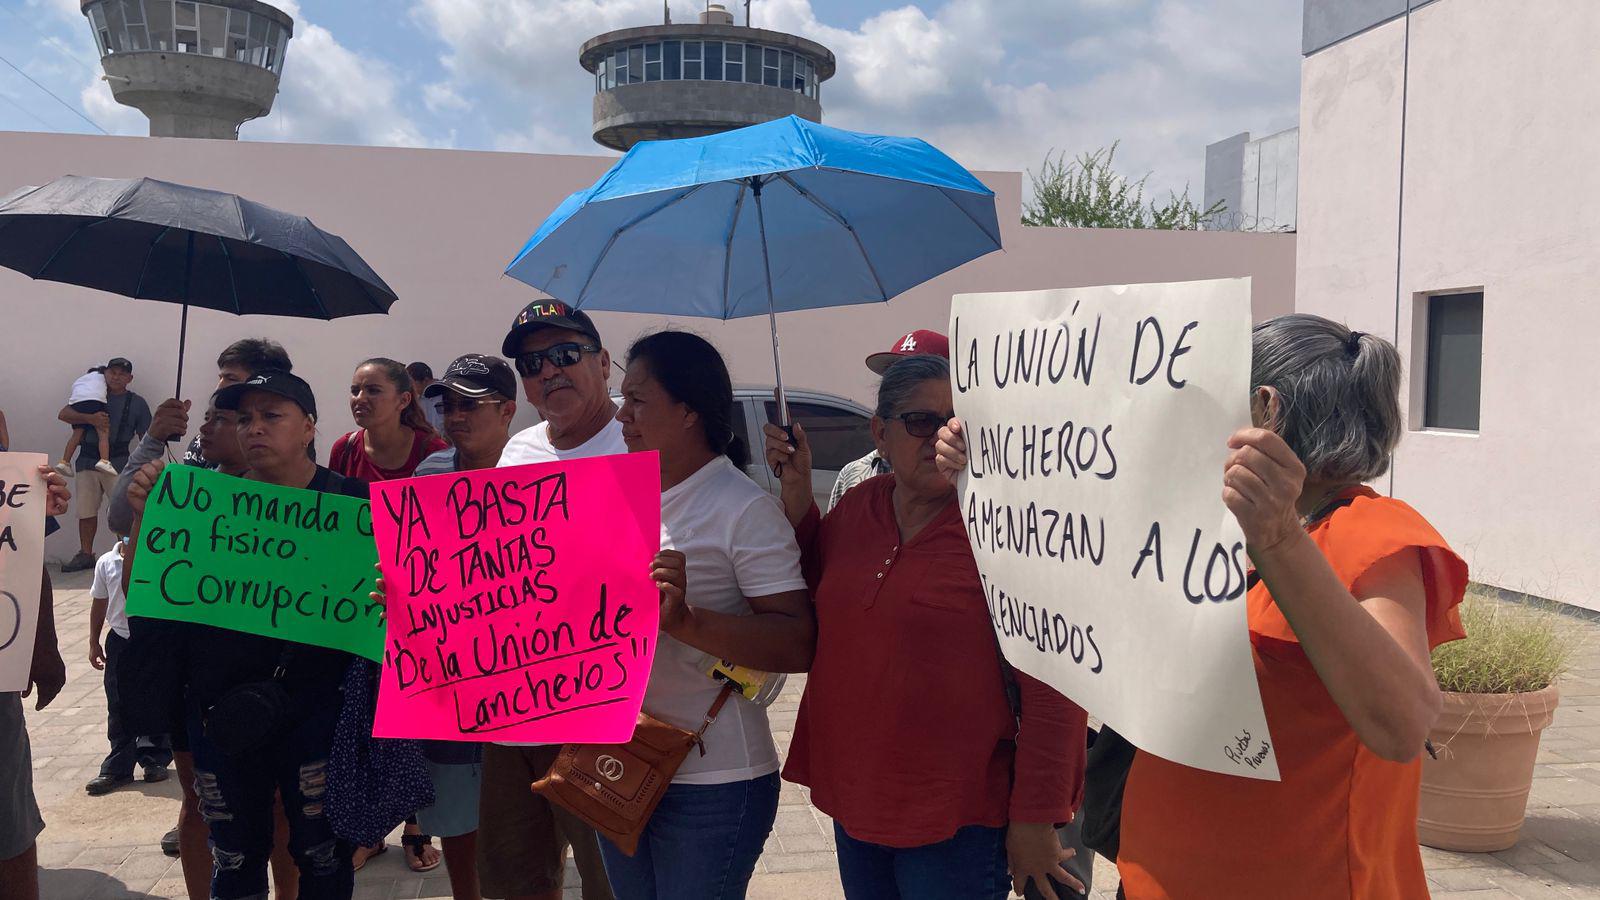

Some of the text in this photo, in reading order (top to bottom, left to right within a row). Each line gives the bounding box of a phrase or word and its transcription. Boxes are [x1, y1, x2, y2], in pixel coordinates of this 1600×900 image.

[955, 300, 1199, 393] LA UNIÓN DE
[965, 421, 1117, 480] LANCHEROS
[146, 526, 190, 553] en
[157, 471, 212, 510] No
[232, 491, 339, 533] manda
[381, 485, 431, 566] YA
[446, 471, 569, 539] BASTA
[403, 527, 555, 597] DE TANTAS
[968, 491, 1246, 604] AMENAZAN A LOS
[407, 569, 558, 645] INJUSTICIAS
[436, 646, 462, 680] la
[473, 611, 575, 676] Unión
[589, 583, 633, 643] de
